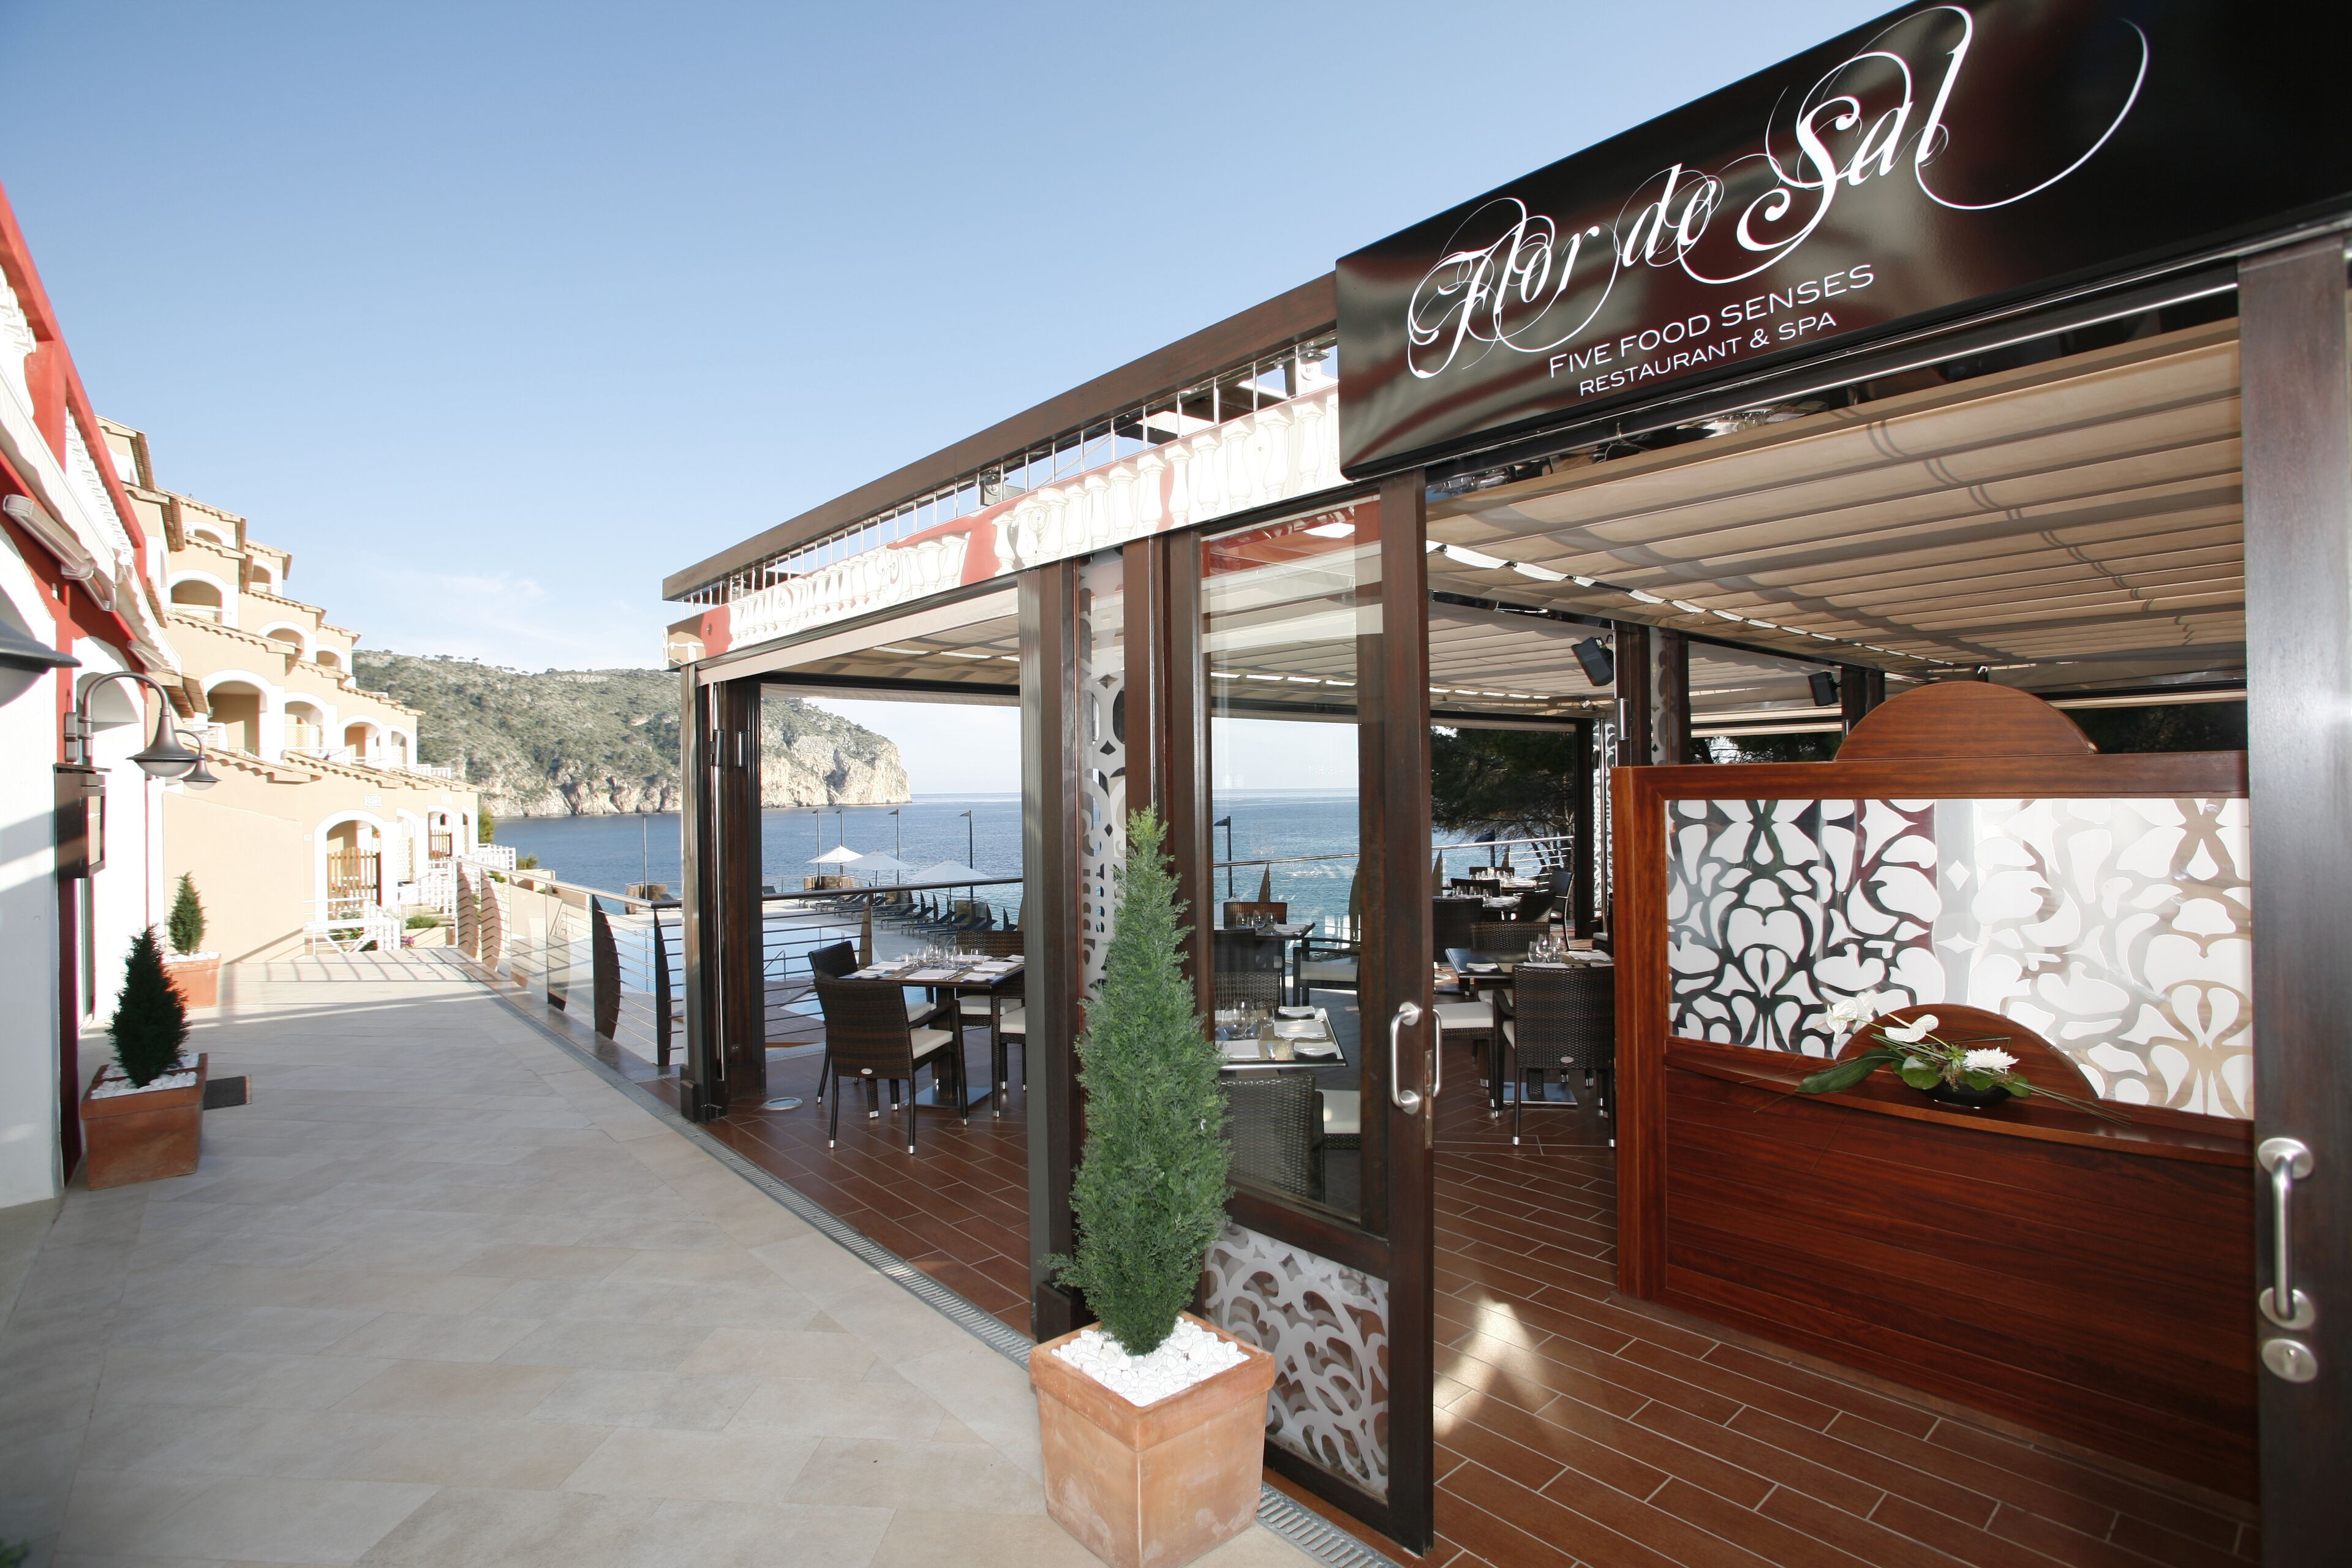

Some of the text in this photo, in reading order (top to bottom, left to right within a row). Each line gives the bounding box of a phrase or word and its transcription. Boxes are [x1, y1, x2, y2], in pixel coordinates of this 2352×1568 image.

[1614, 164, 1723, 267] de
[1549, 264, 1874, 379] FIVE FOOD SENSES
[1580, 312, 1836, 396] RESTAURANT & SPA
